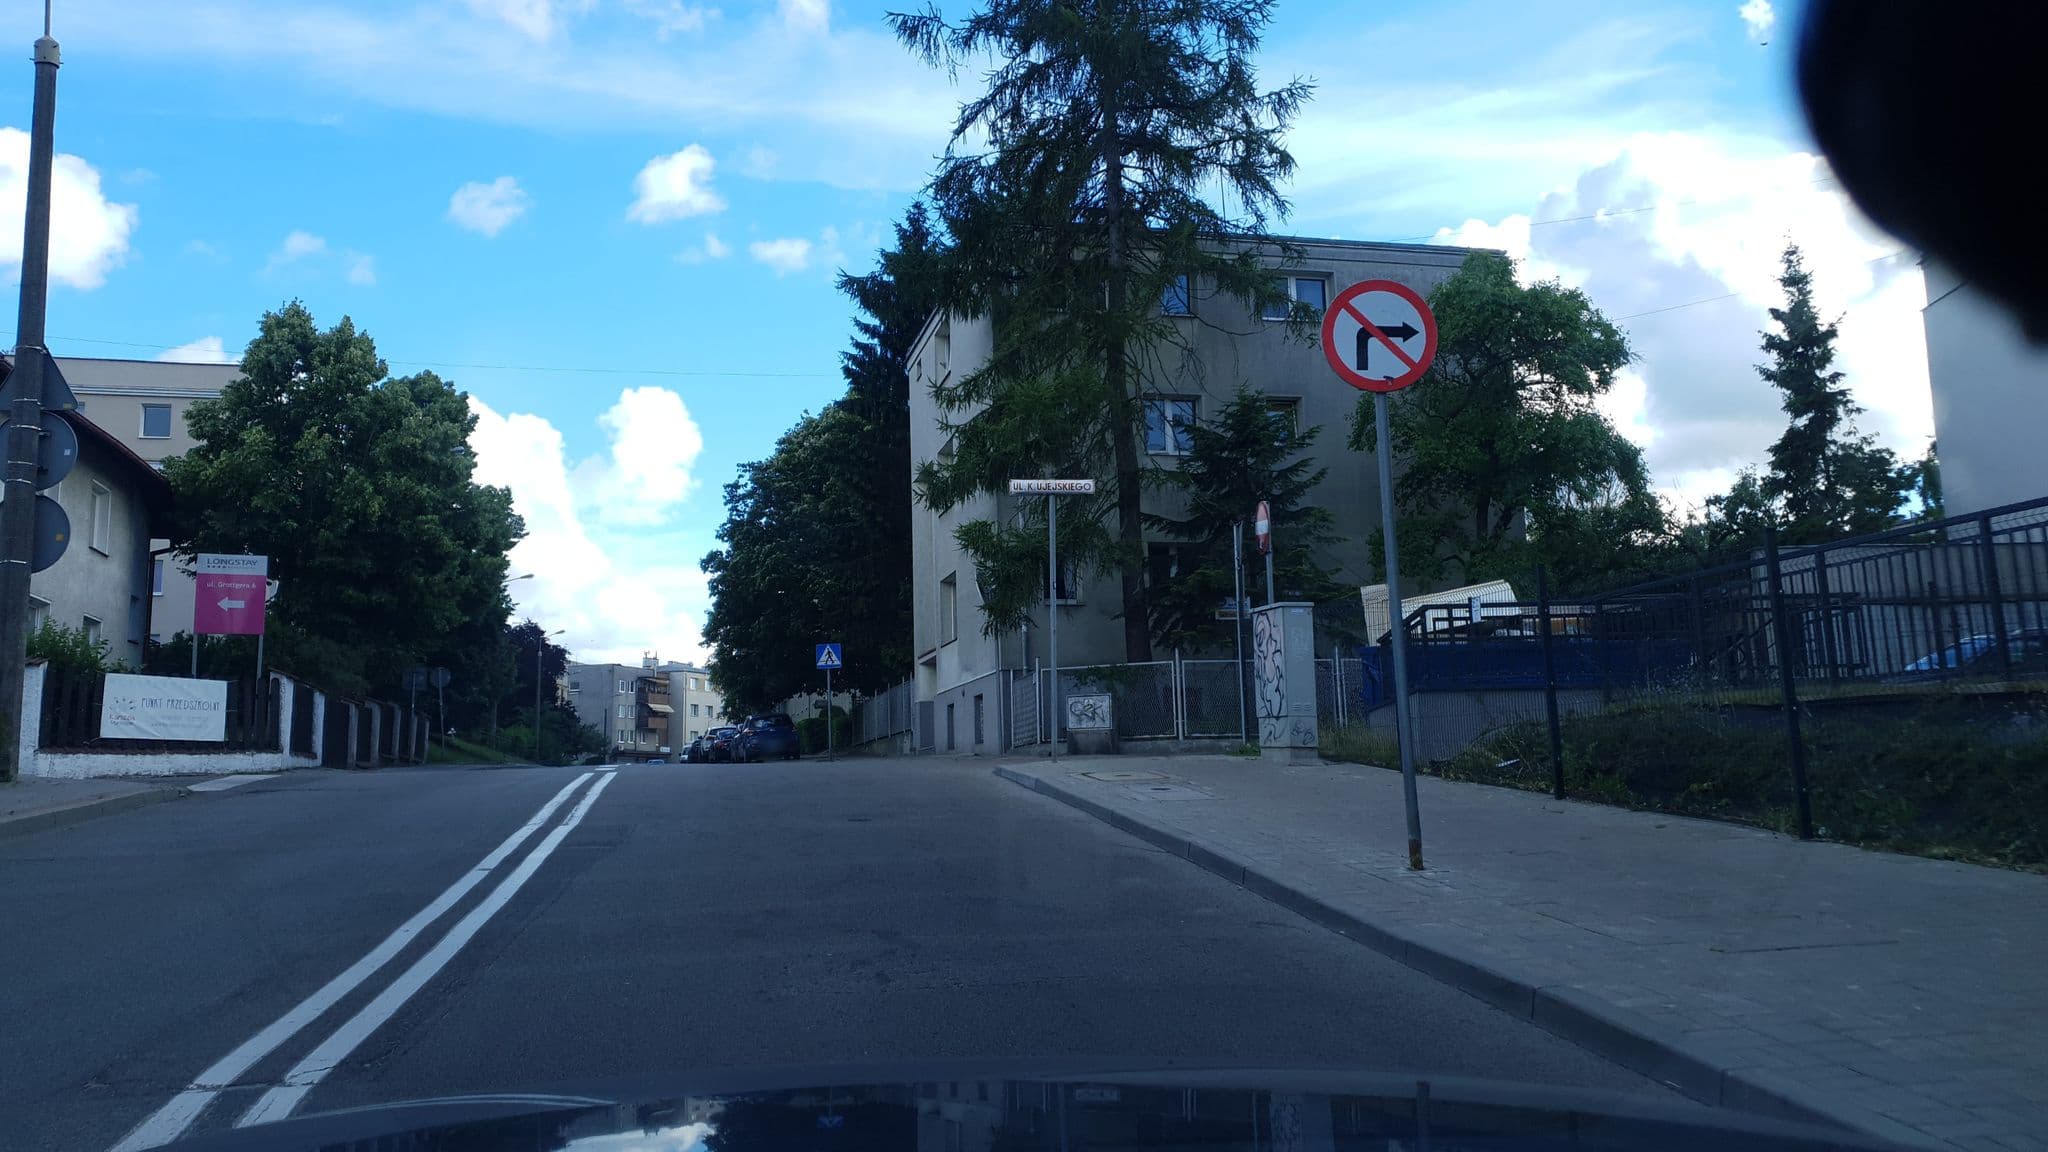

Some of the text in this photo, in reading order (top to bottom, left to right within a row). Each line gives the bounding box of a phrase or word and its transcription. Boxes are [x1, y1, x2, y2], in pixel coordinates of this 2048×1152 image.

[1036, 482, 1092, 491] UJEJSKIEGO
[207, 558, 258, 566] LONGSTAY
[141, 698, 163, 709] PUNKT
